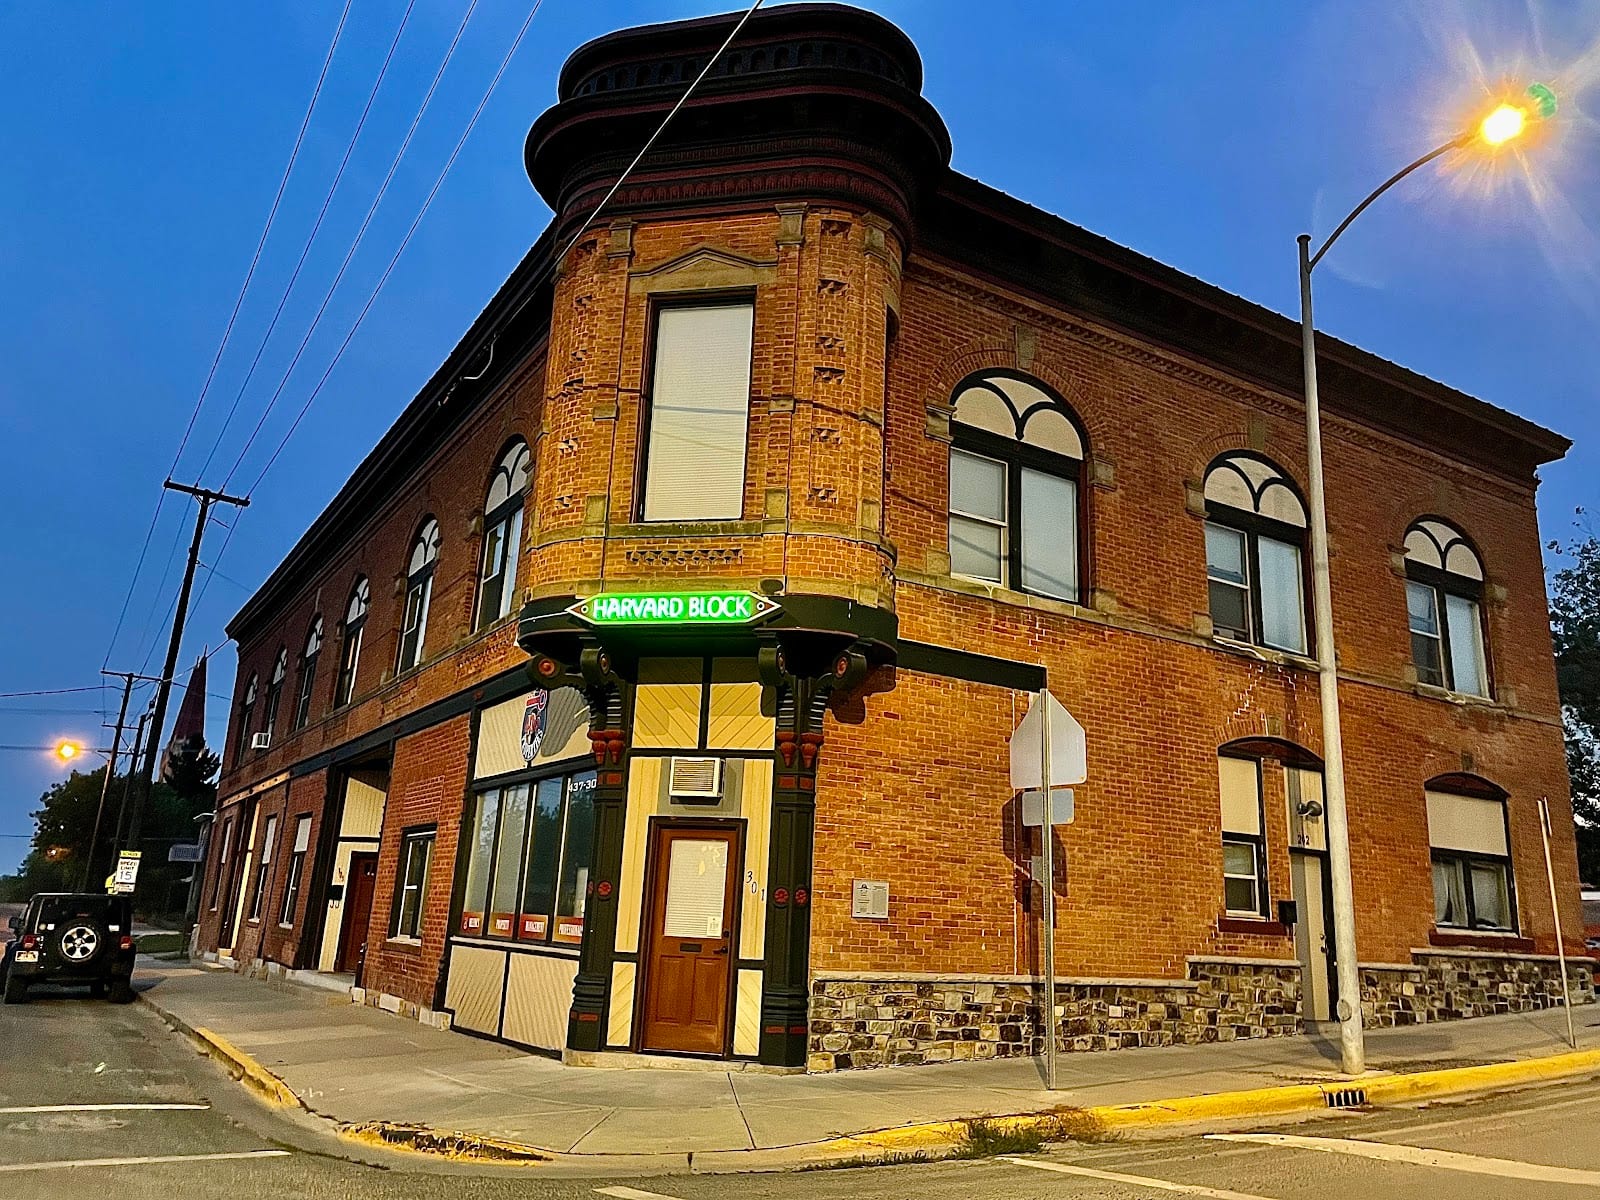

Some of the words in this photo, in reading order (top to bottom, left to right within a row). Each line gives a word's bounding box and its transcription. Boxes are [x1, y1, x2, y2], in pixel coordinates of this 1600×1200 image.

[592, 597, 684, 619] HARVARD
[688, 595, 750, 618] BLOCK
[120, 871, 132, 881] 15
[746, 870, 765, 902] 301
